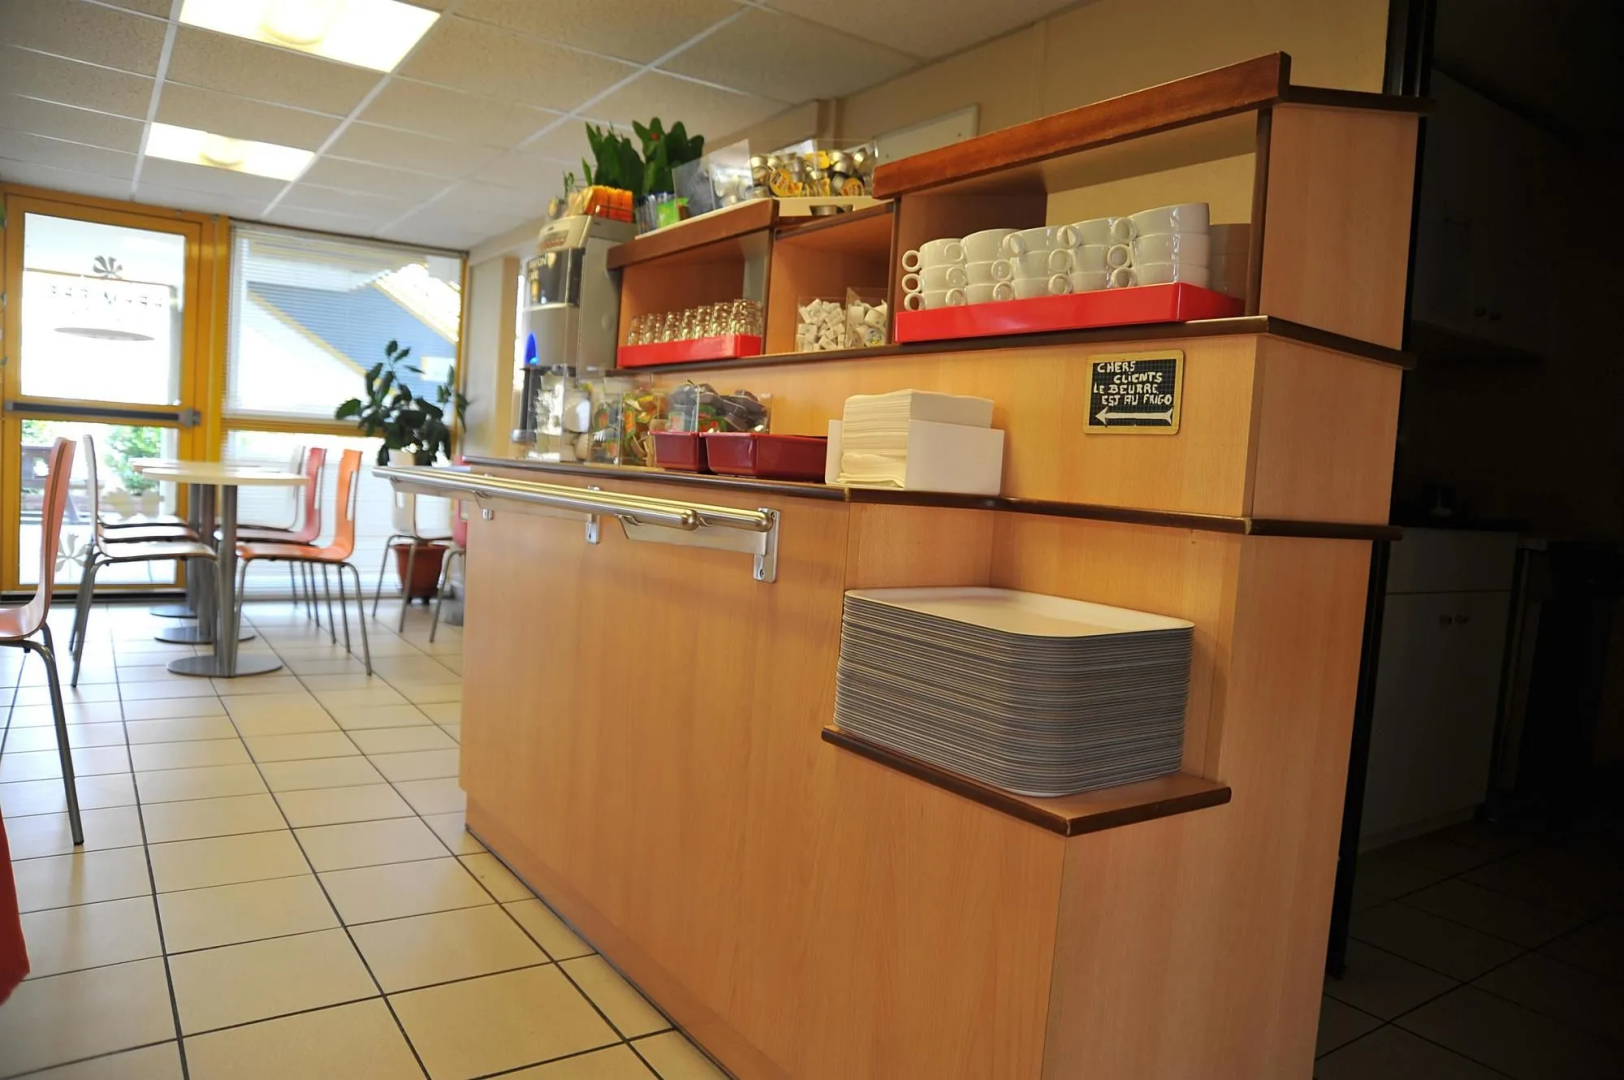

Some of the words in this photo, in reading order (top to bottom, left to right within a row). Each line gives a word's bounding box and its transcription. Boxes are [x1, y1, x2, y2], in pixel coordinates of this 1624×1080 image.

[1097, 361, 1136, 373] CHERS
[1108, 383, 1159, 394] BEURRE
[1101, 394, 1121, 406] EST
[1124, 394, 1138, 406] AU
